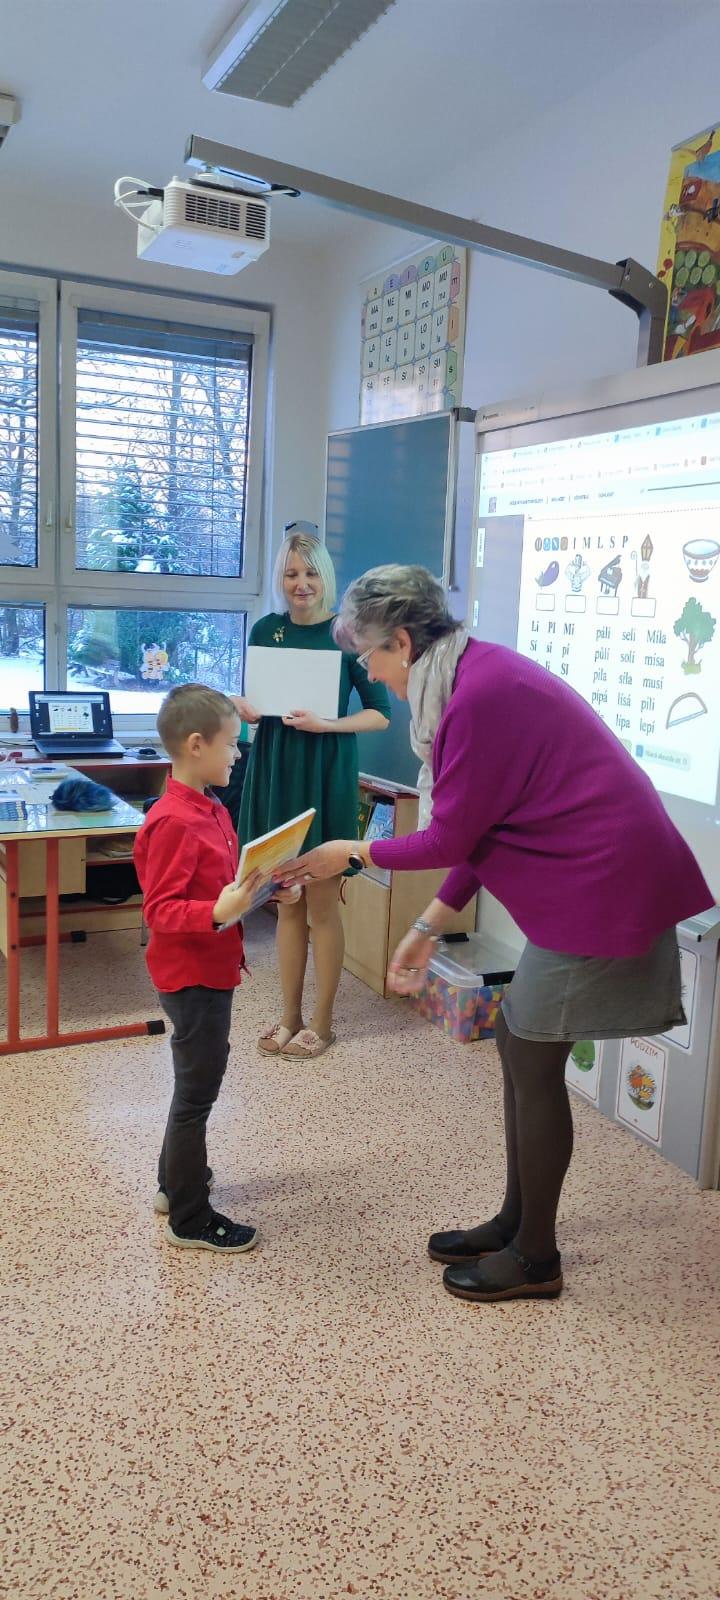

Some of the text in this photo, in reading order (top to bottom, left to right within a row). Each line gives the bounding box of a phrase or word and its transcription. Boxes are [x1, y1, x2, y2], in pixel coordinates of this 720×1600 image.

[424, 261, 429, 271] O
[442, 251, 447, 261] U
[370, 305, 379, 315] MA
[387, 297, 395, 307] ME
[405, 289, 412, 299] MI
[422, 281, 431, 292] MO
[439, 271, 448, 283] MU
[368, 344, 376, 353] LA
[385, 337, 392, 347] LE
[403, 331, 409, 341] LI
[420, 323, 428, 334] LO
[436, 314, 444, 327] LU
[583, 536, 591, 549] M
[597, 536, 604, 549] L
[610, 535, 616, 549] S
[622, 535, 629, 549] P
[531, 620, 540, 633] Li
[563, 622, 575, 636] Mi
